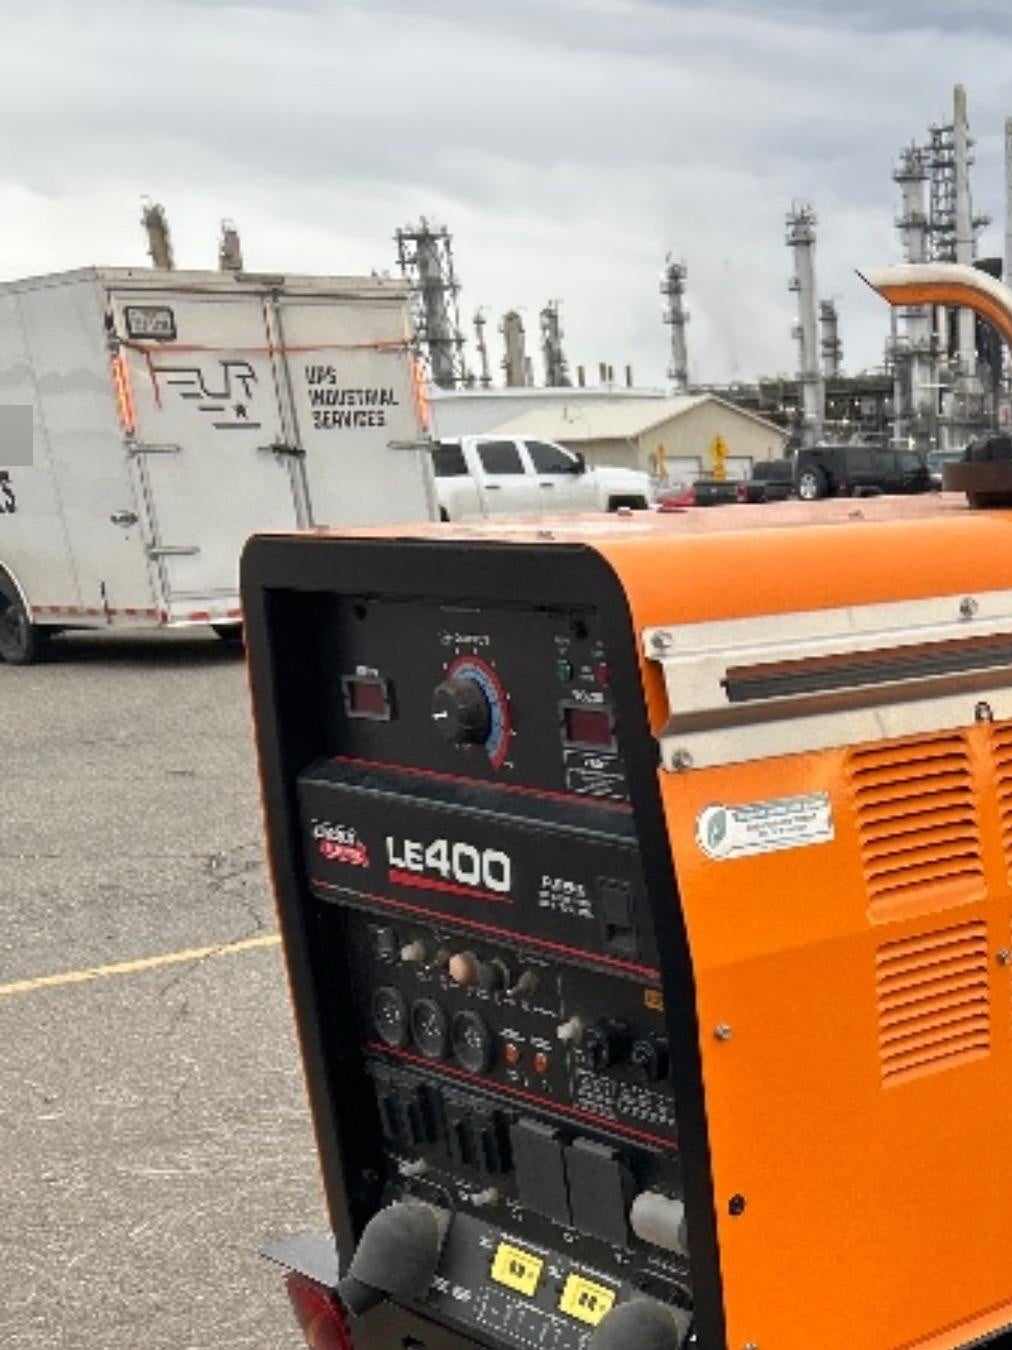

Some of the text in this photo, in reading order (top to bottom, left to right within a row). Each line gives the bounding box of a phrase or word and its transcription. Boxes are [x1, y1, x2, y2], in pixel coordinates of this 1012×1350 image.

[308, 388, 399, 407] INDUSTRIAL
[312, 410, 385, 429] SERVICES
[386, 836, 511, 892] LE400
